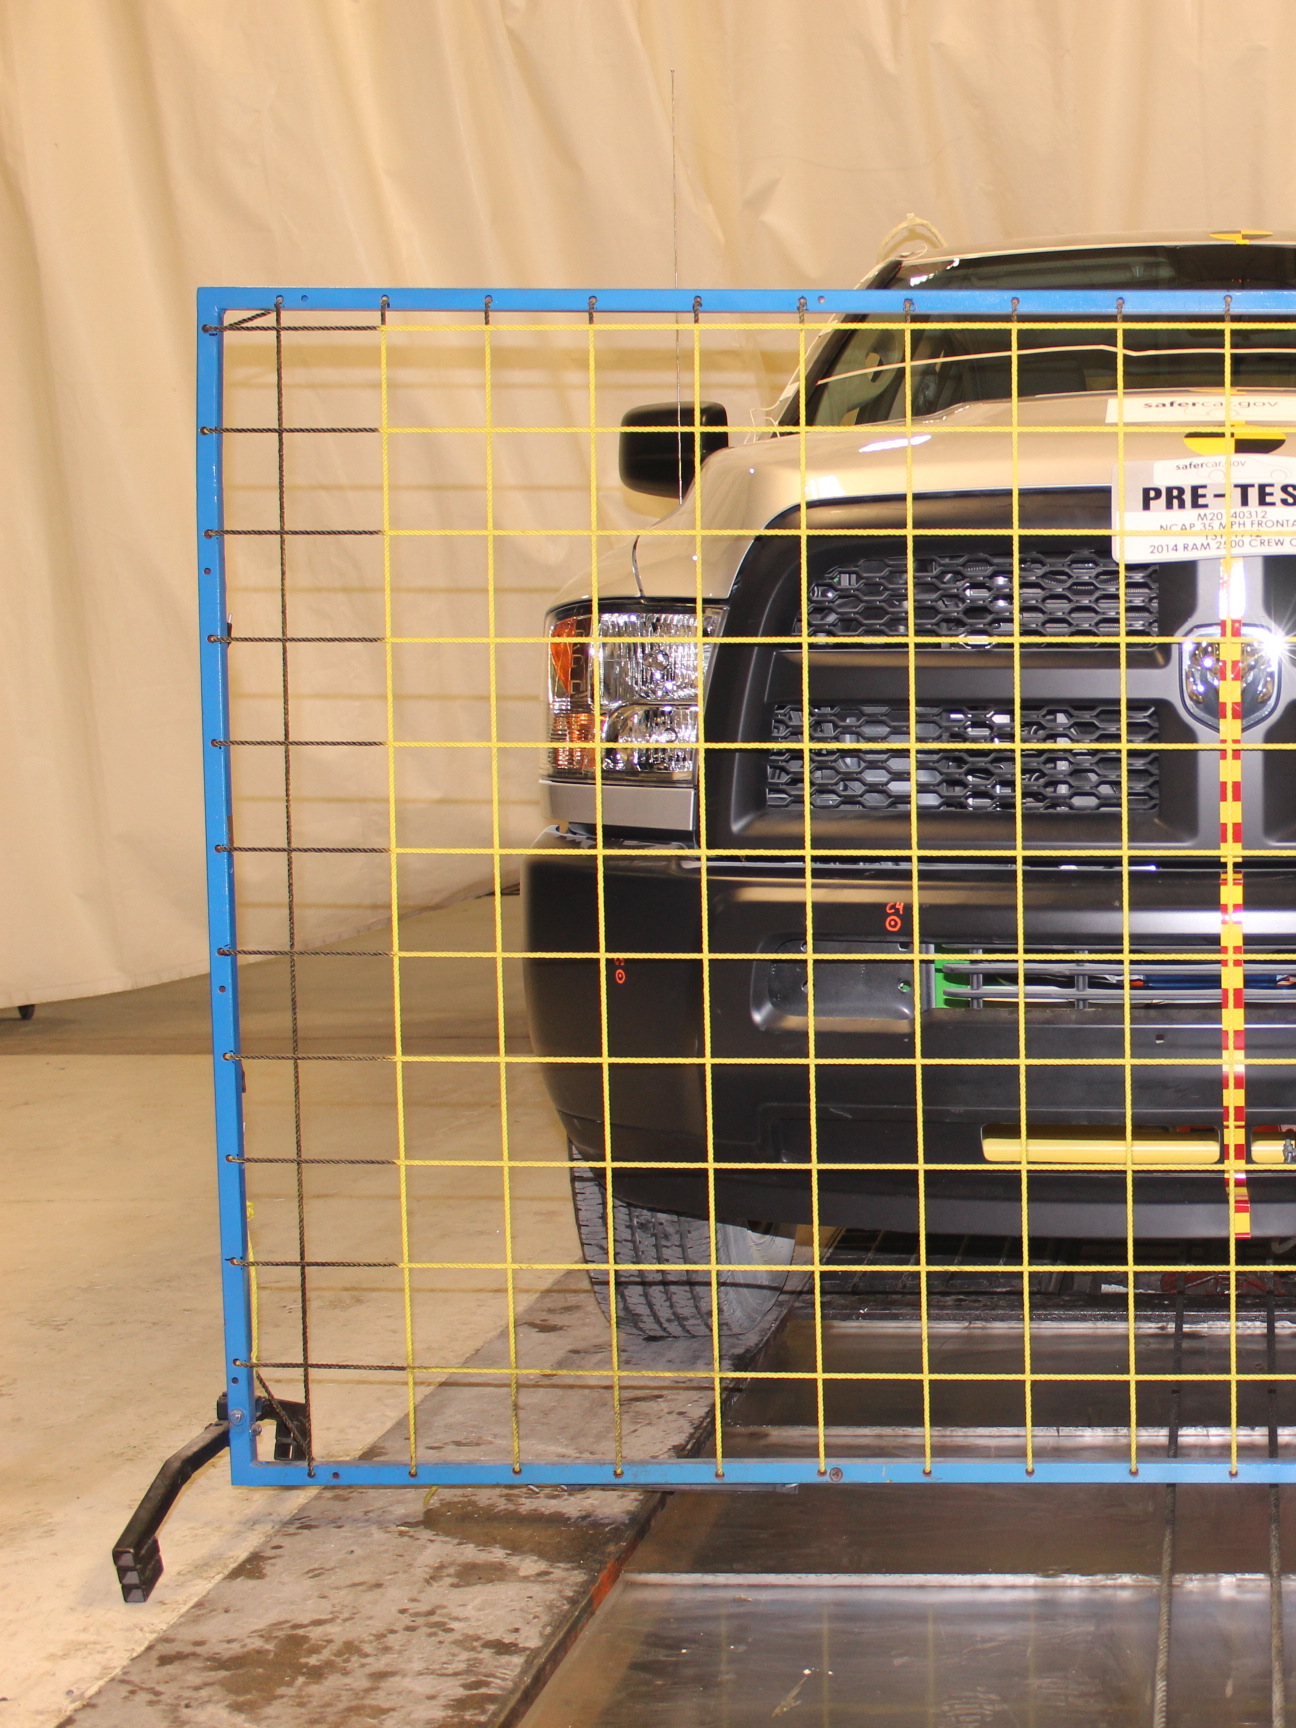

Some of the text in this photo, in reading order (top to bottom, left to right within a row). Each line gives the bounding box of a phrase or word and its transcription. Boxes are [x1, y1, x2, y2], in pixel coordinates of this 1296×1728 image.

[1143, 400, 1279, 409] saferca.gov
[1197, 510, 1268, 521] M2040312
[1159, 523, 1196, 531] NCAP
[1200, 522, 1214, 531] 35
[1149, 543, 1178, 554] 2014
[1183, 542, 1211, 551] RAM
[1249, 538, 1285, 548] CREW
[885, 901, 904, 915] C4
